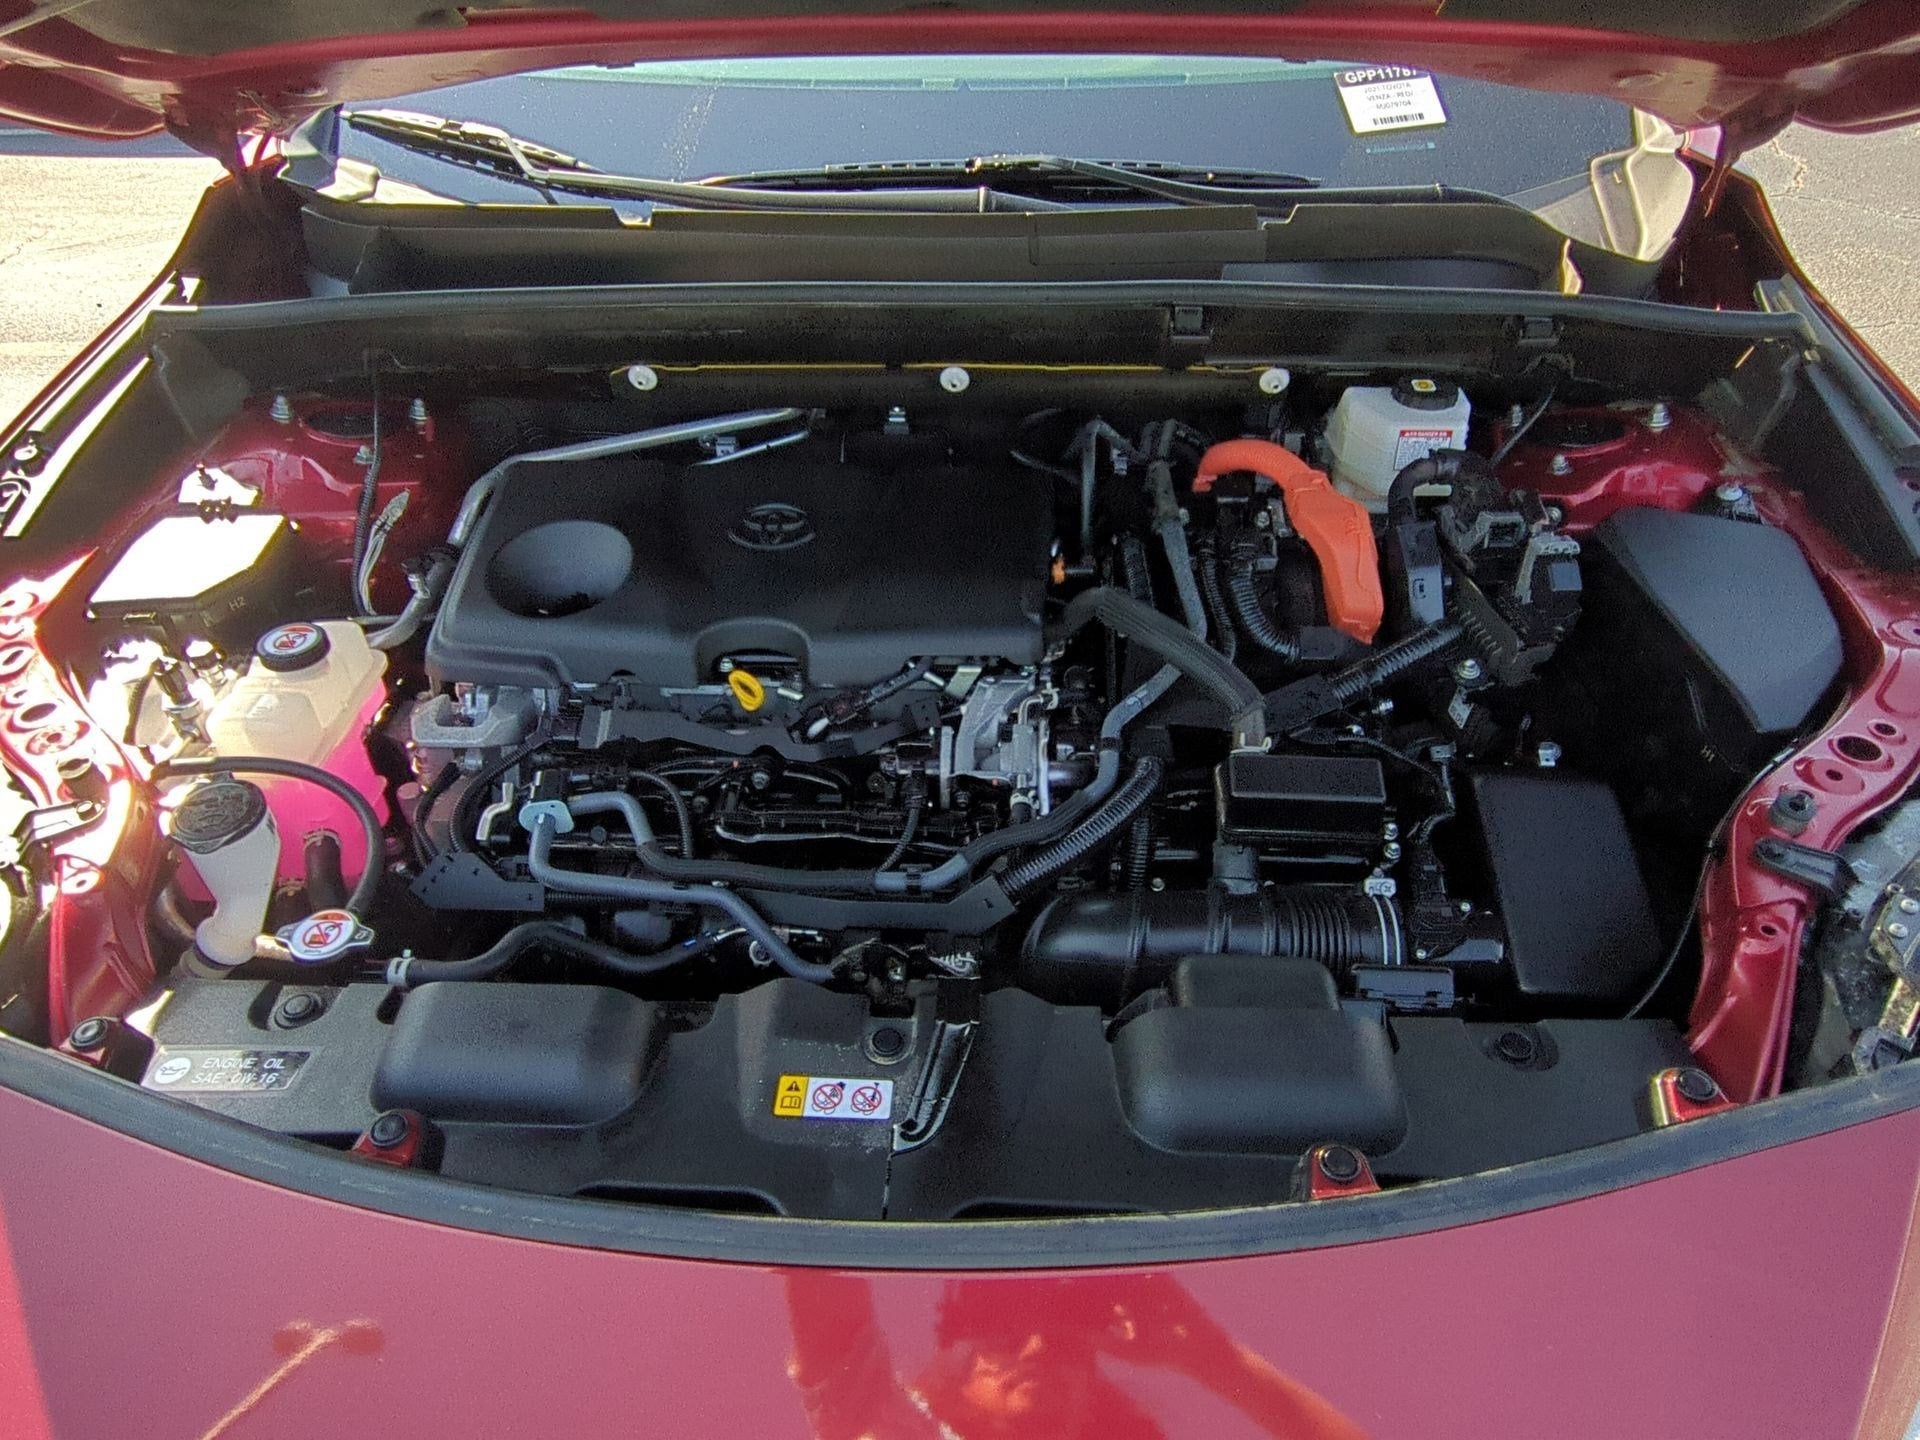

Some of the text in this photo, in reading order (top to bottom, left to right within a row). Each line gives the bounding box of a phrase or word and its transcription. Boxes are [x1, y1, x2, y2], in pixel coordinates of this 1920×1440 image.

[202, 1057, 285, 1069] ENGINE OIL
[191, 1072, 279, 1084] SAE 0W-16
